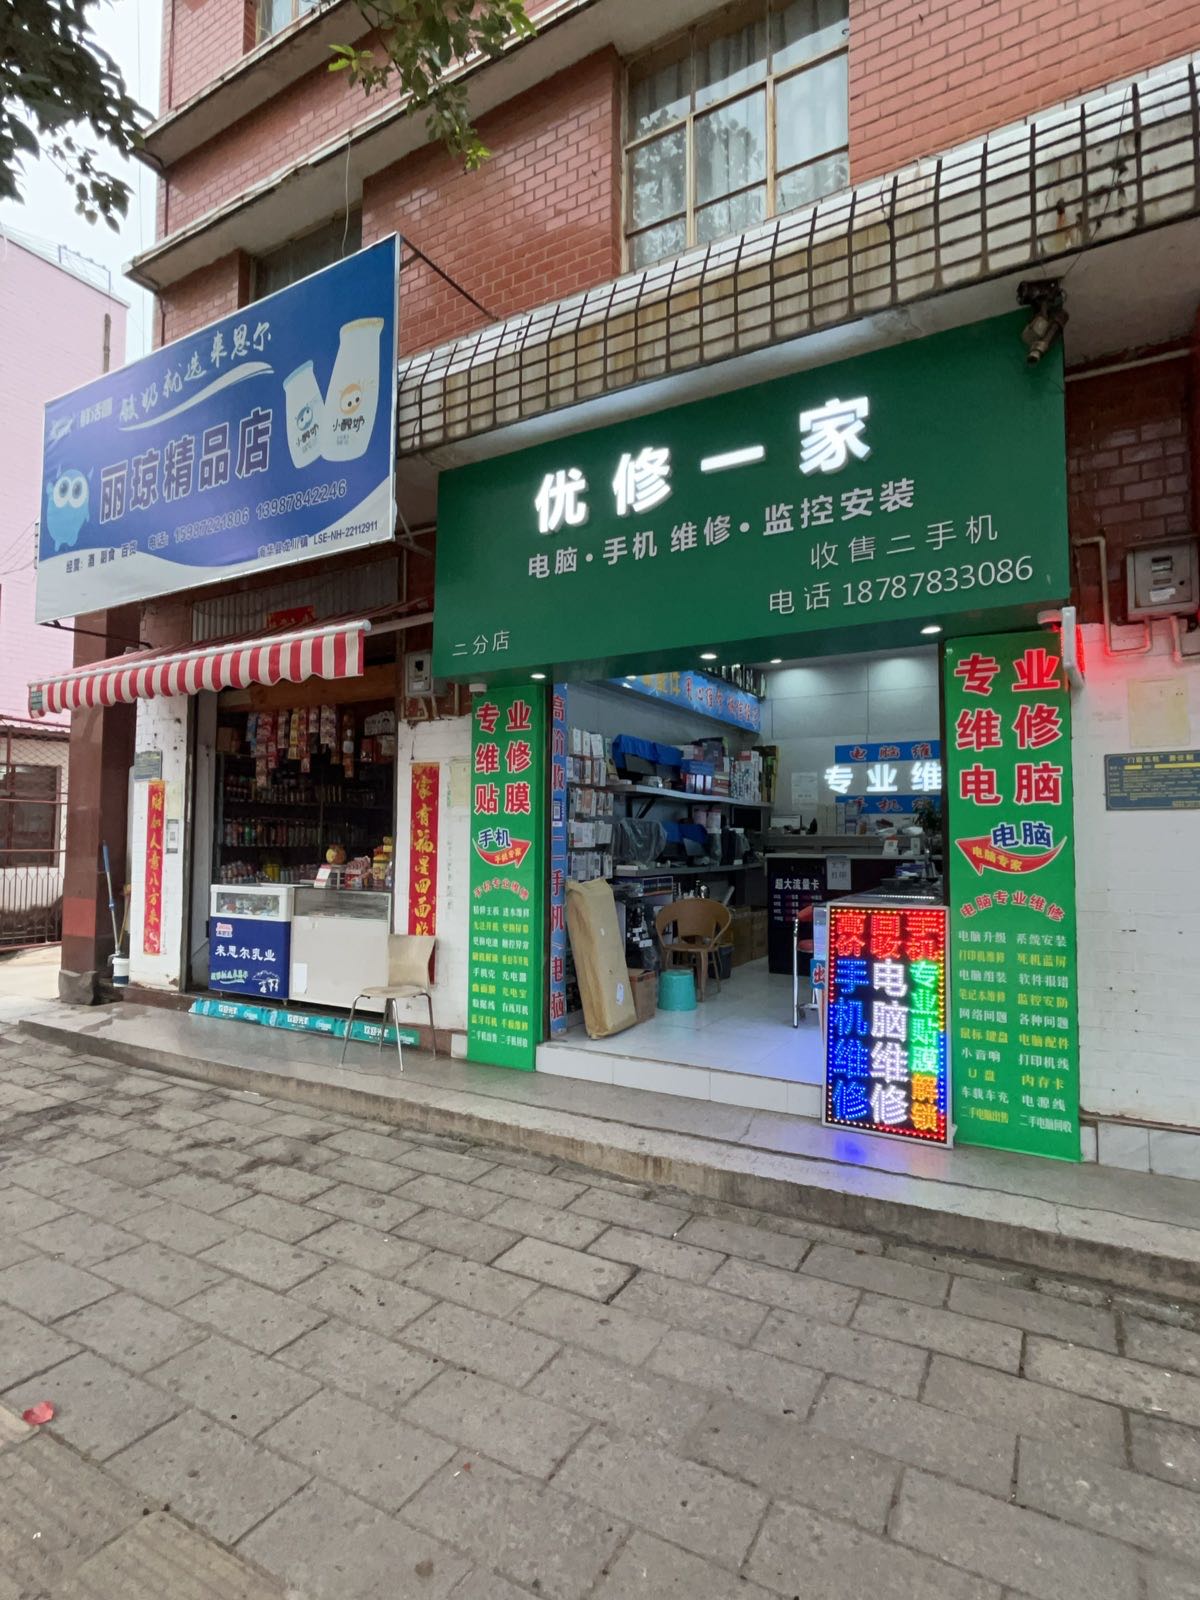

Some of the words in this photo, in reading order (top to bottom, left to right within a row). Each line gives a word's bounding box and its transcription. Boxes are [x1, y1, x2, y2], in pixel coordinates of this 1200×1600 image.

[100, 407, 273, 525] 丽琼精品店
[534, 396, 870, 534] 优修一家
[174, 507, 250, 544] 15987221806
[256, 479, 347, 521] 13987842246
[314, 520, 378, 546] LSE-NH-22112911
[811, 514, 998, 570] 收售二手机
[769, 586, 832, 616] 电话
[842, 555, 1034, 607] 18787833086
[452, 630, 510, 656] 二分店
[954, 648, 1061, 696] 专业
[475, 699, 531, 734] 专业
[955, 703, 1064, 751] 维修
[475, 740, 532, 774] 维修
[474, 781, 531, 815] 贴膜
[959, 762, 1063, 806] 电脑
[478, 828, 512, 849] 手机
[991, 821, 1053, 849] 电脑
[972, 846, 1024, 872] 电脑专家
[961, 889, 1065, 921] 电脑专业维修
[958, 930, 1006, 943] 电脑升级
[1016, 933, 1068, 947] 系统安装
[1019, 973, 1069, 988] 软件报错
[959, 1008, 1007, 1024] 网络问题
[1020, 1013, 1069, 1029] 各种问题
[832, 960, 870, 1120] 手机维修
[870, 958, 909, 1125] 电脑维修
[1019, 1034, 1069, 1050] 电脑配件
[962, 1047, 1001, 1062] 小音响
[1019, 1054, 1069, 1071] 打印机线
[1021, 1074, 1064, 1090] 内存卡
[961, 1086, 1009, 1104] 车载车充
[1022, 1094, 1066, 1112] 电源线
[1020, 1114, 1072, 1133] 二手电脑回收
